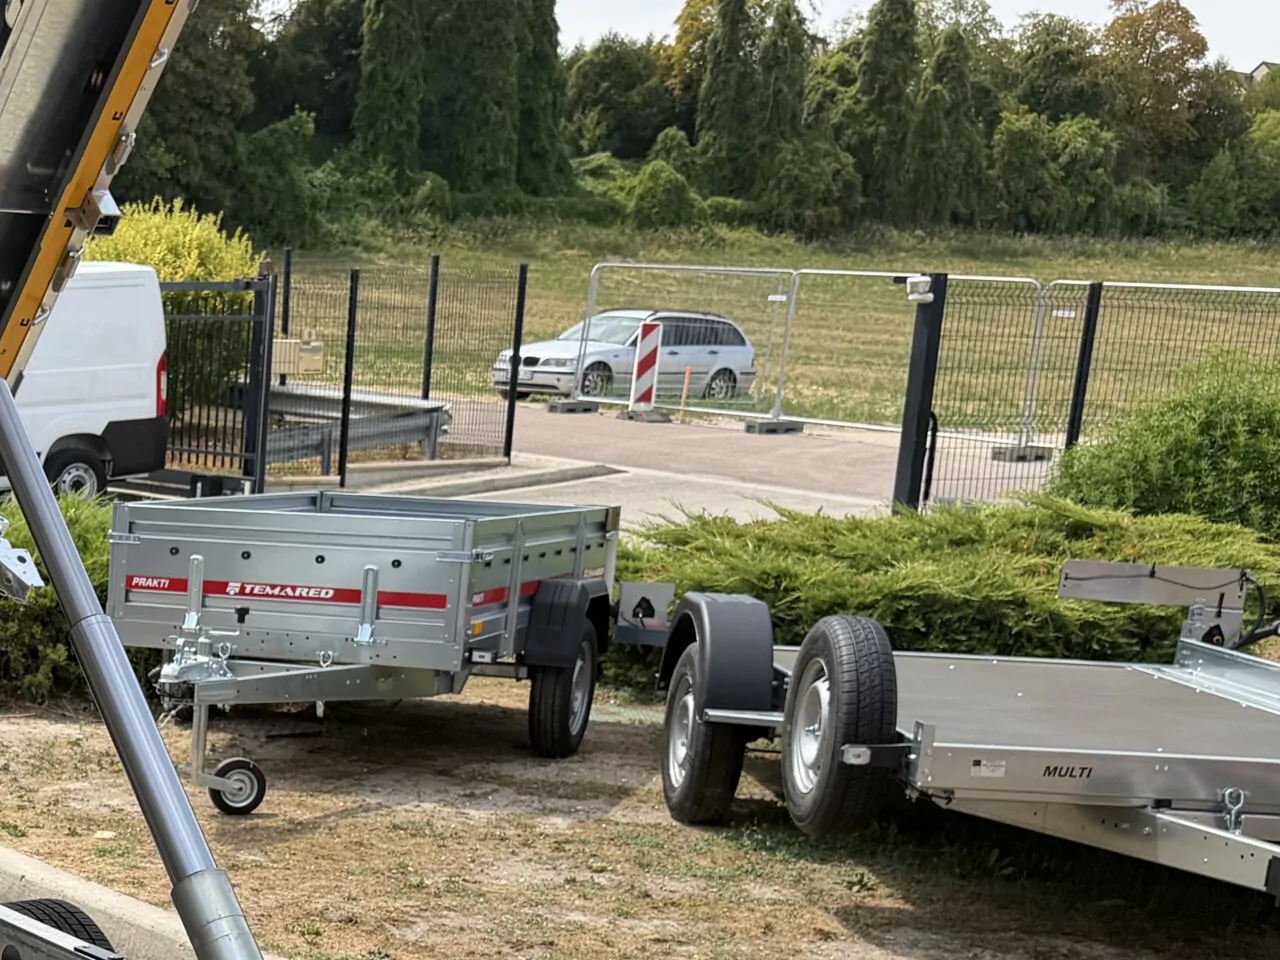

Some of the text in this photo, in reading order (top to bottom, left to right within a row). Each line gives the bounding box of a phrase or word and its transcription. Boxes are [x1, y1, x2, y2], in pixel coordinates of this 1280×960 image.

[131, 576, 170, 589] PRAKTI
[243, 583, 335, 599] TEMARED
[1042, 765, 1093, 779] MULTI
